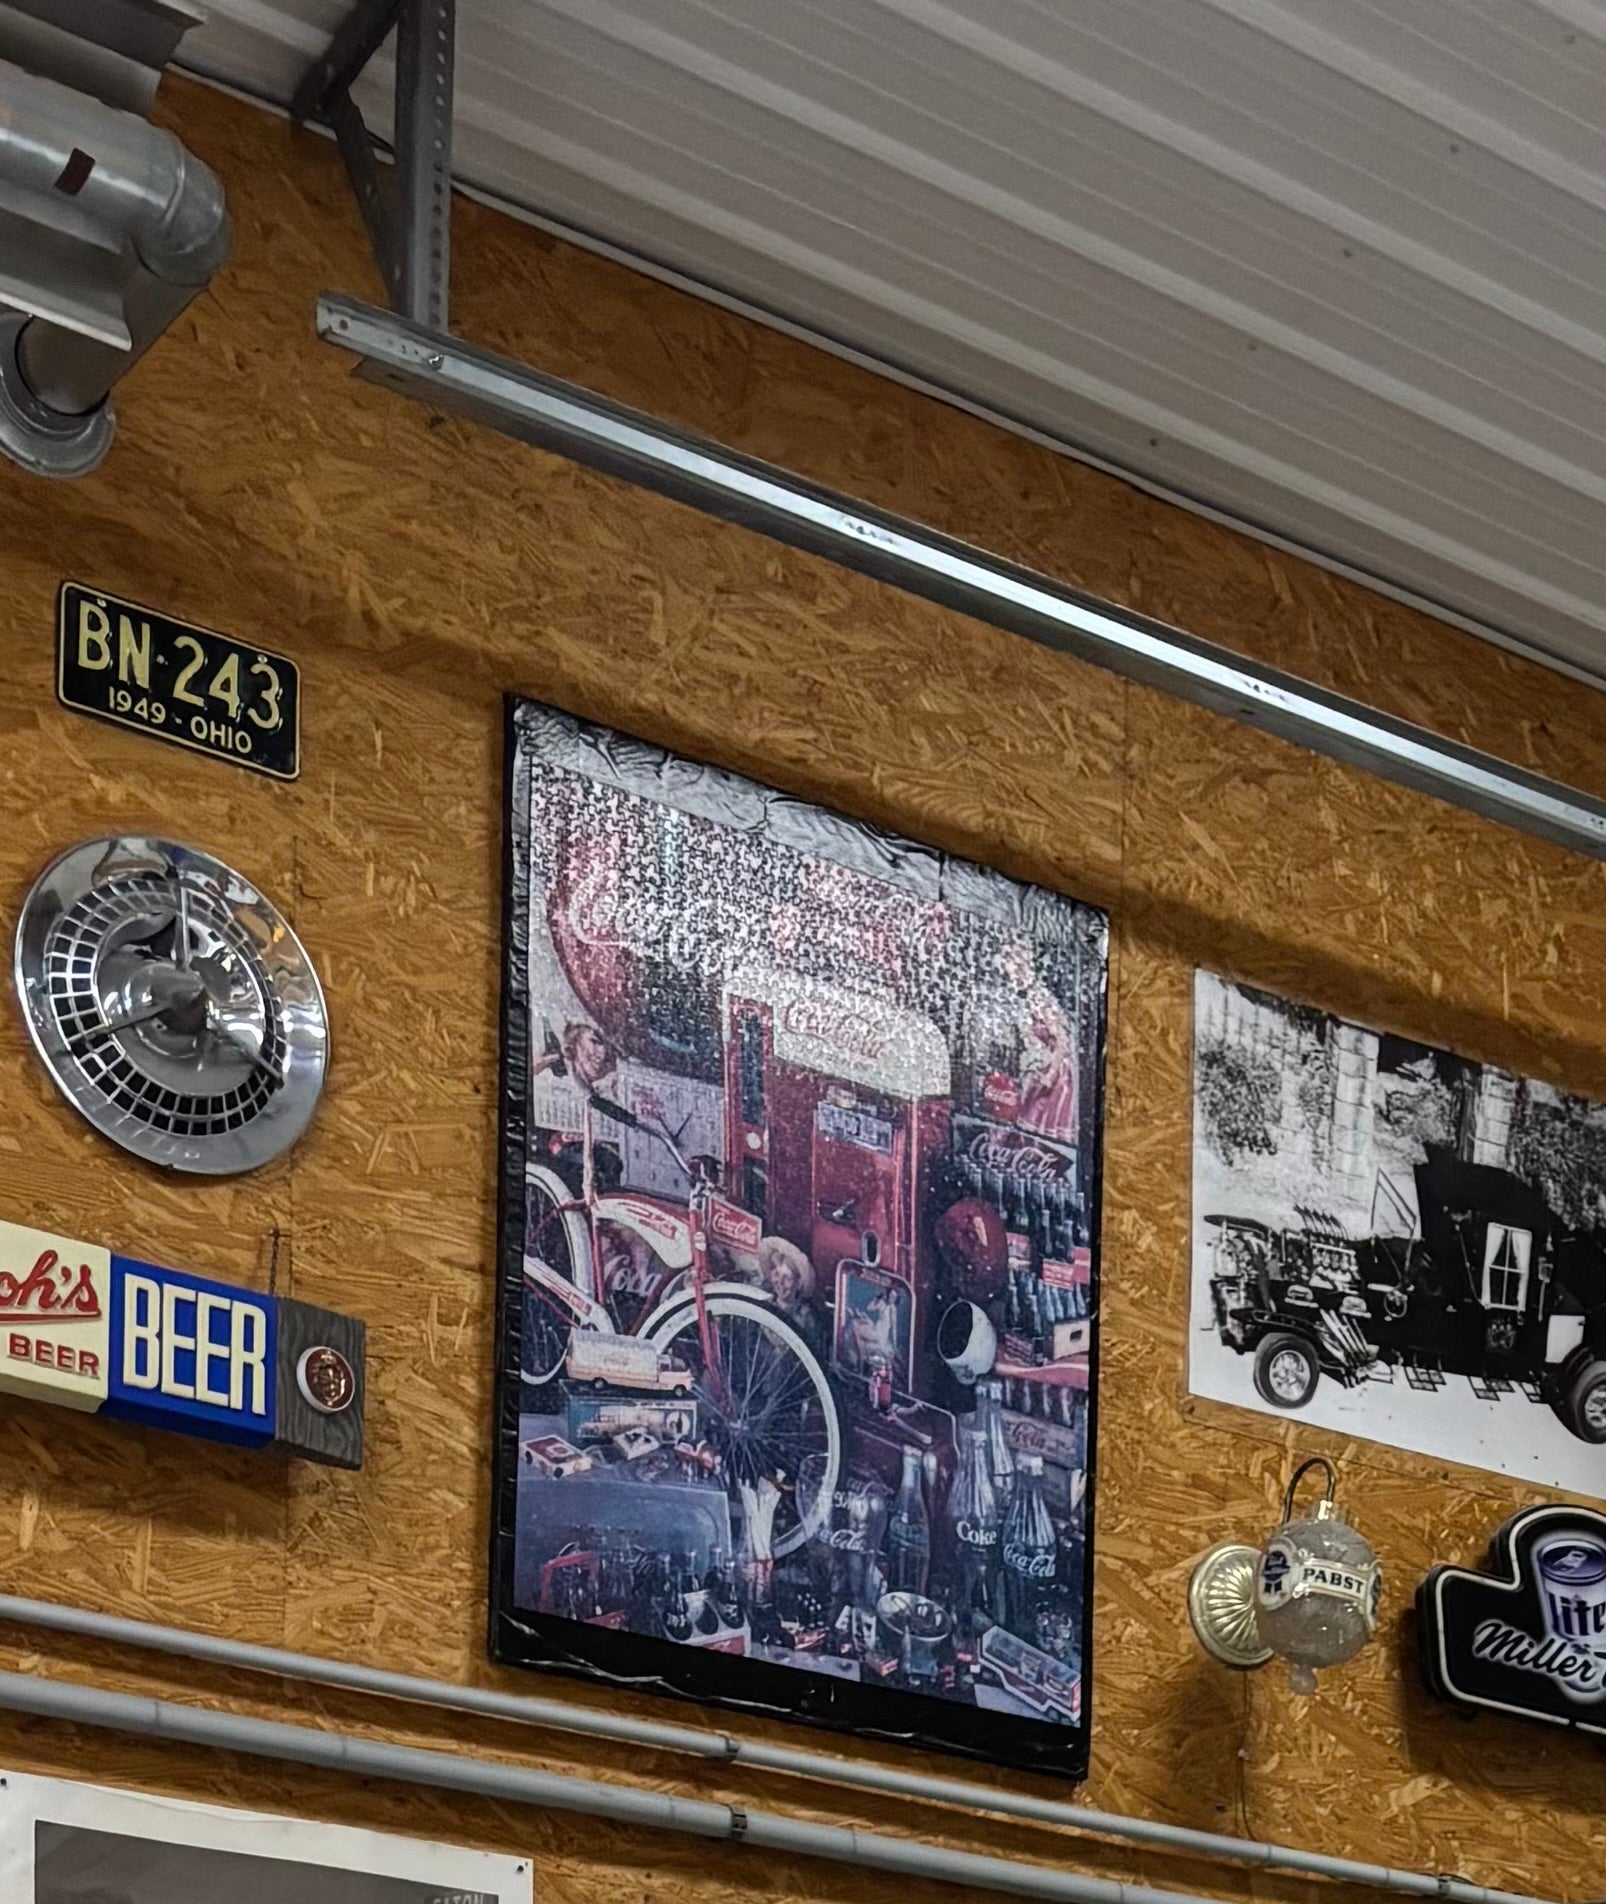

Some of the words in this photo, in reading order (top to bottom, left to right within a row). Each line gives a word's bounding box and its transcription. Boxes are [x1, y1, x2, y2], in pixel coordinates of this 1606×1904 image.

[109, 686, 166, 724] 1949
[190, 715, 252, 754] OHIO
[9, 1333, 99, 1377] BEER
[123, 1272, 267, 1416] BEER
[956, 1520, 996, 1546] Coke
[1302, 1568, 1364, 1594] PABST
[1474, 1619, 1597, 1684] Miller
